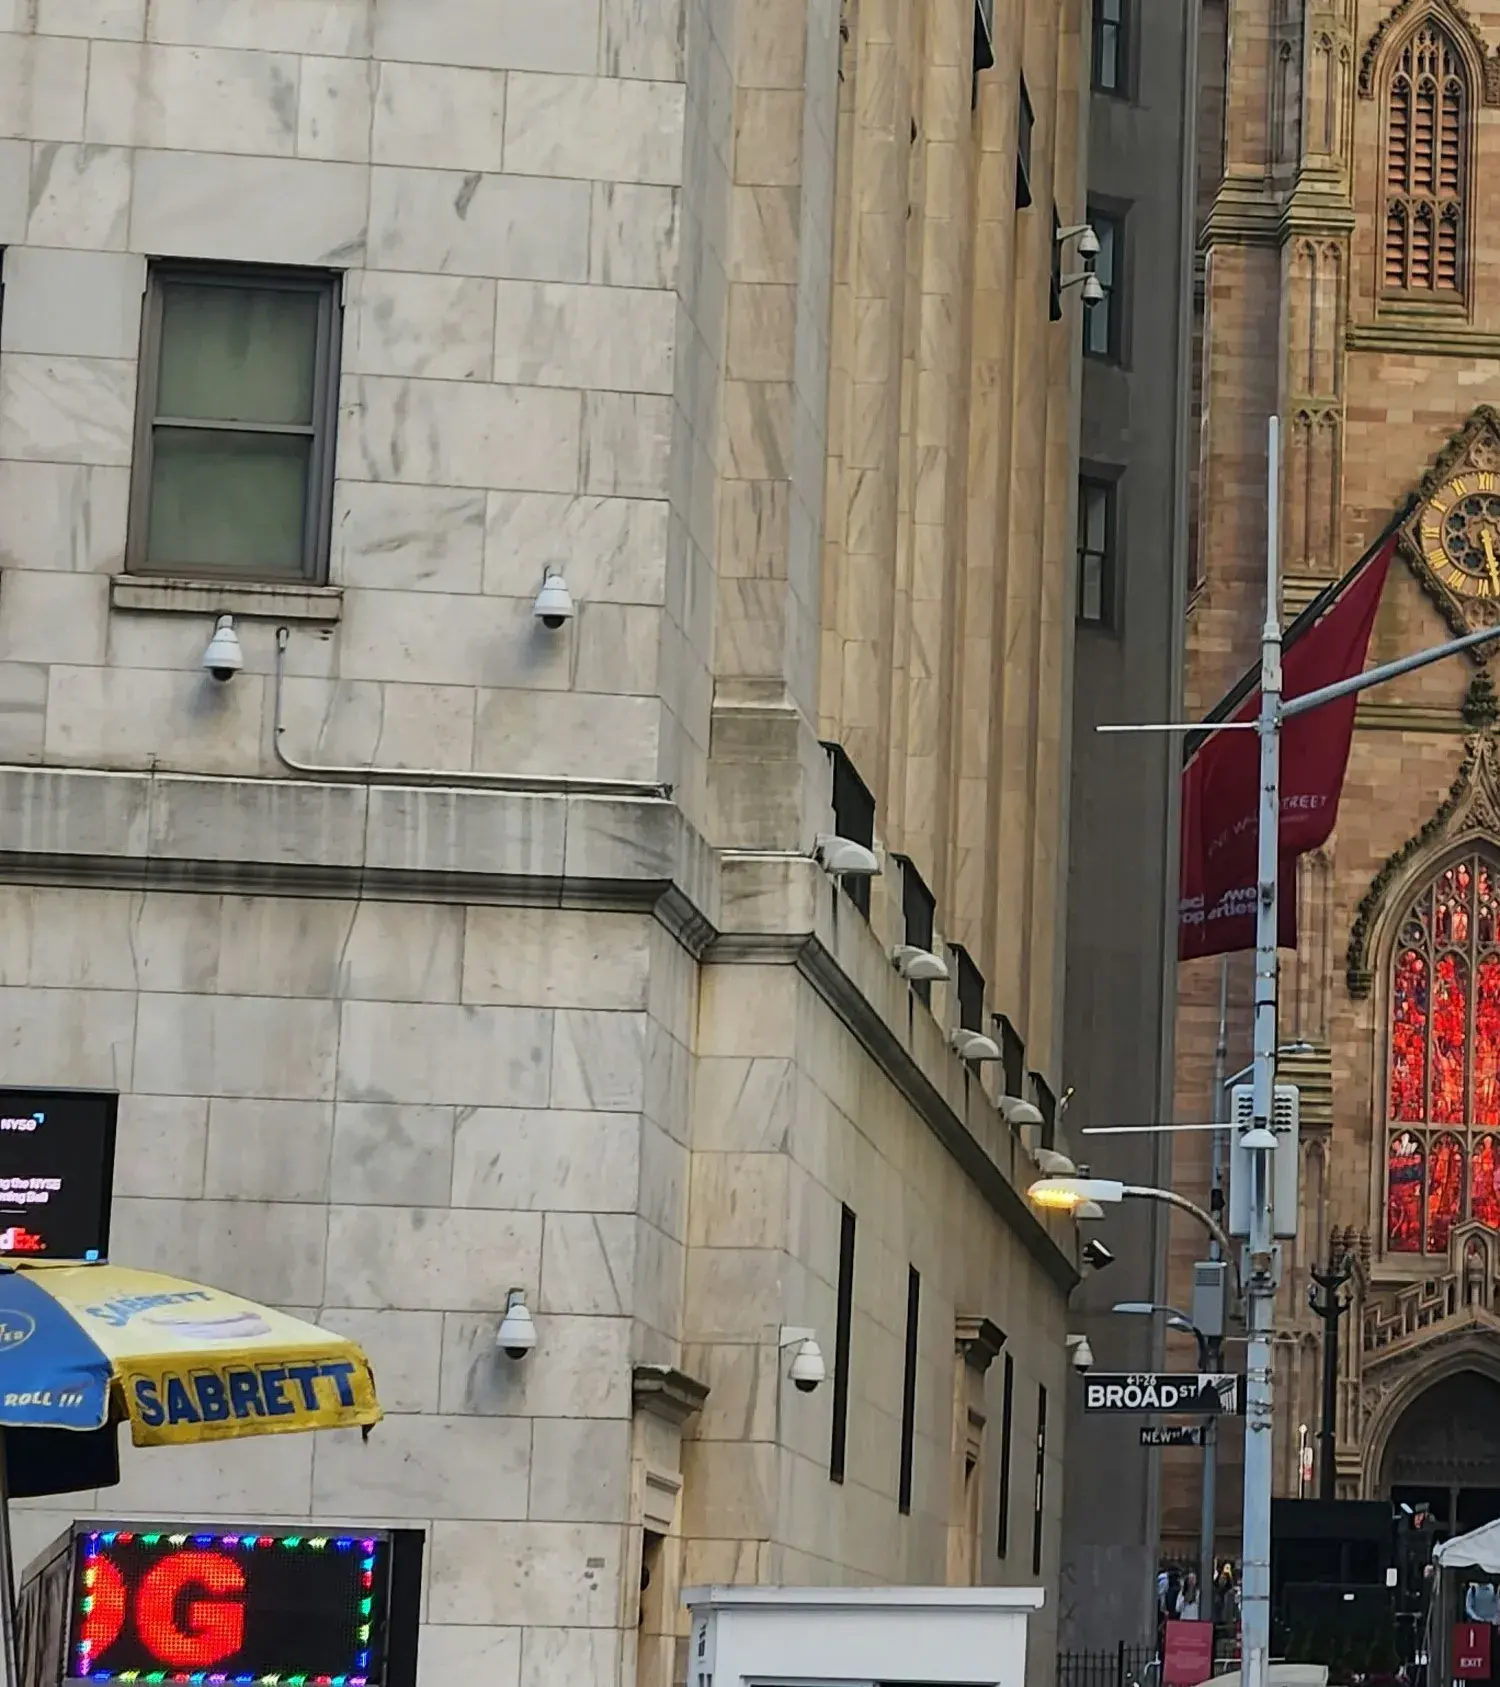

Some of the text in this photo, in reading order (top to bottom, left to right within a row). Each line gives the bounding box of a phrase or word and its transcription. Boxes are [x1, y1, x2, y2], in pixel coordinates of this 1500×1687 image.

[4, 1392, 52, 1407] ROLL
[131, 1359, 356, 1427] SABRETT
[1088, 1385, 1197, 1407] BROAD ST
[1142, 1431, 1172, 1444] NEW
[1459, 1658, 1482, 1668] EXIT
